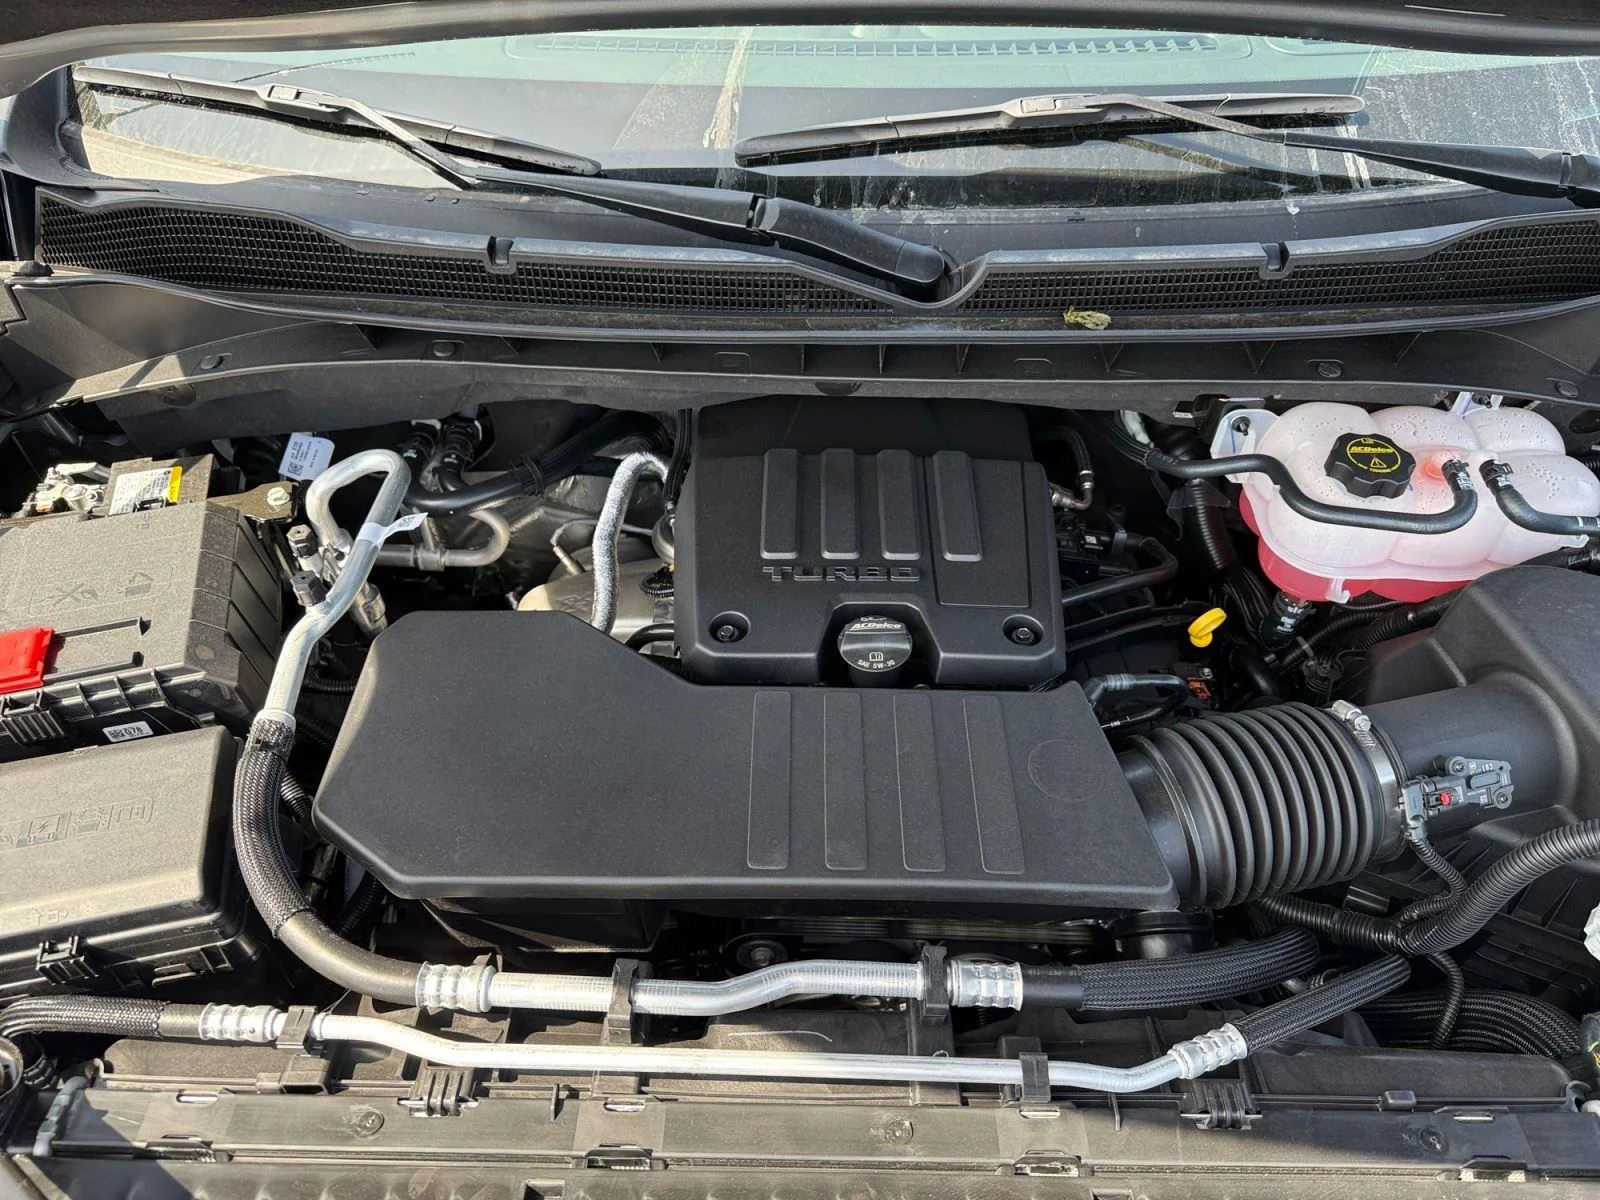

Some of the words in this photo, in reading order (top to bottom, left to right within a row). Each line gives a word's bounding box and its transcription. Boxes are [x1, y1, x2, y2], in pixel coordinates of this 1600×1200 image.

[1350, 445, 1395, 454] ACDelco
[762, 566, 921, 582] TURBO
[849, 622, 902, 631] ACDelco
[857, 659, 870, 668] SAE
